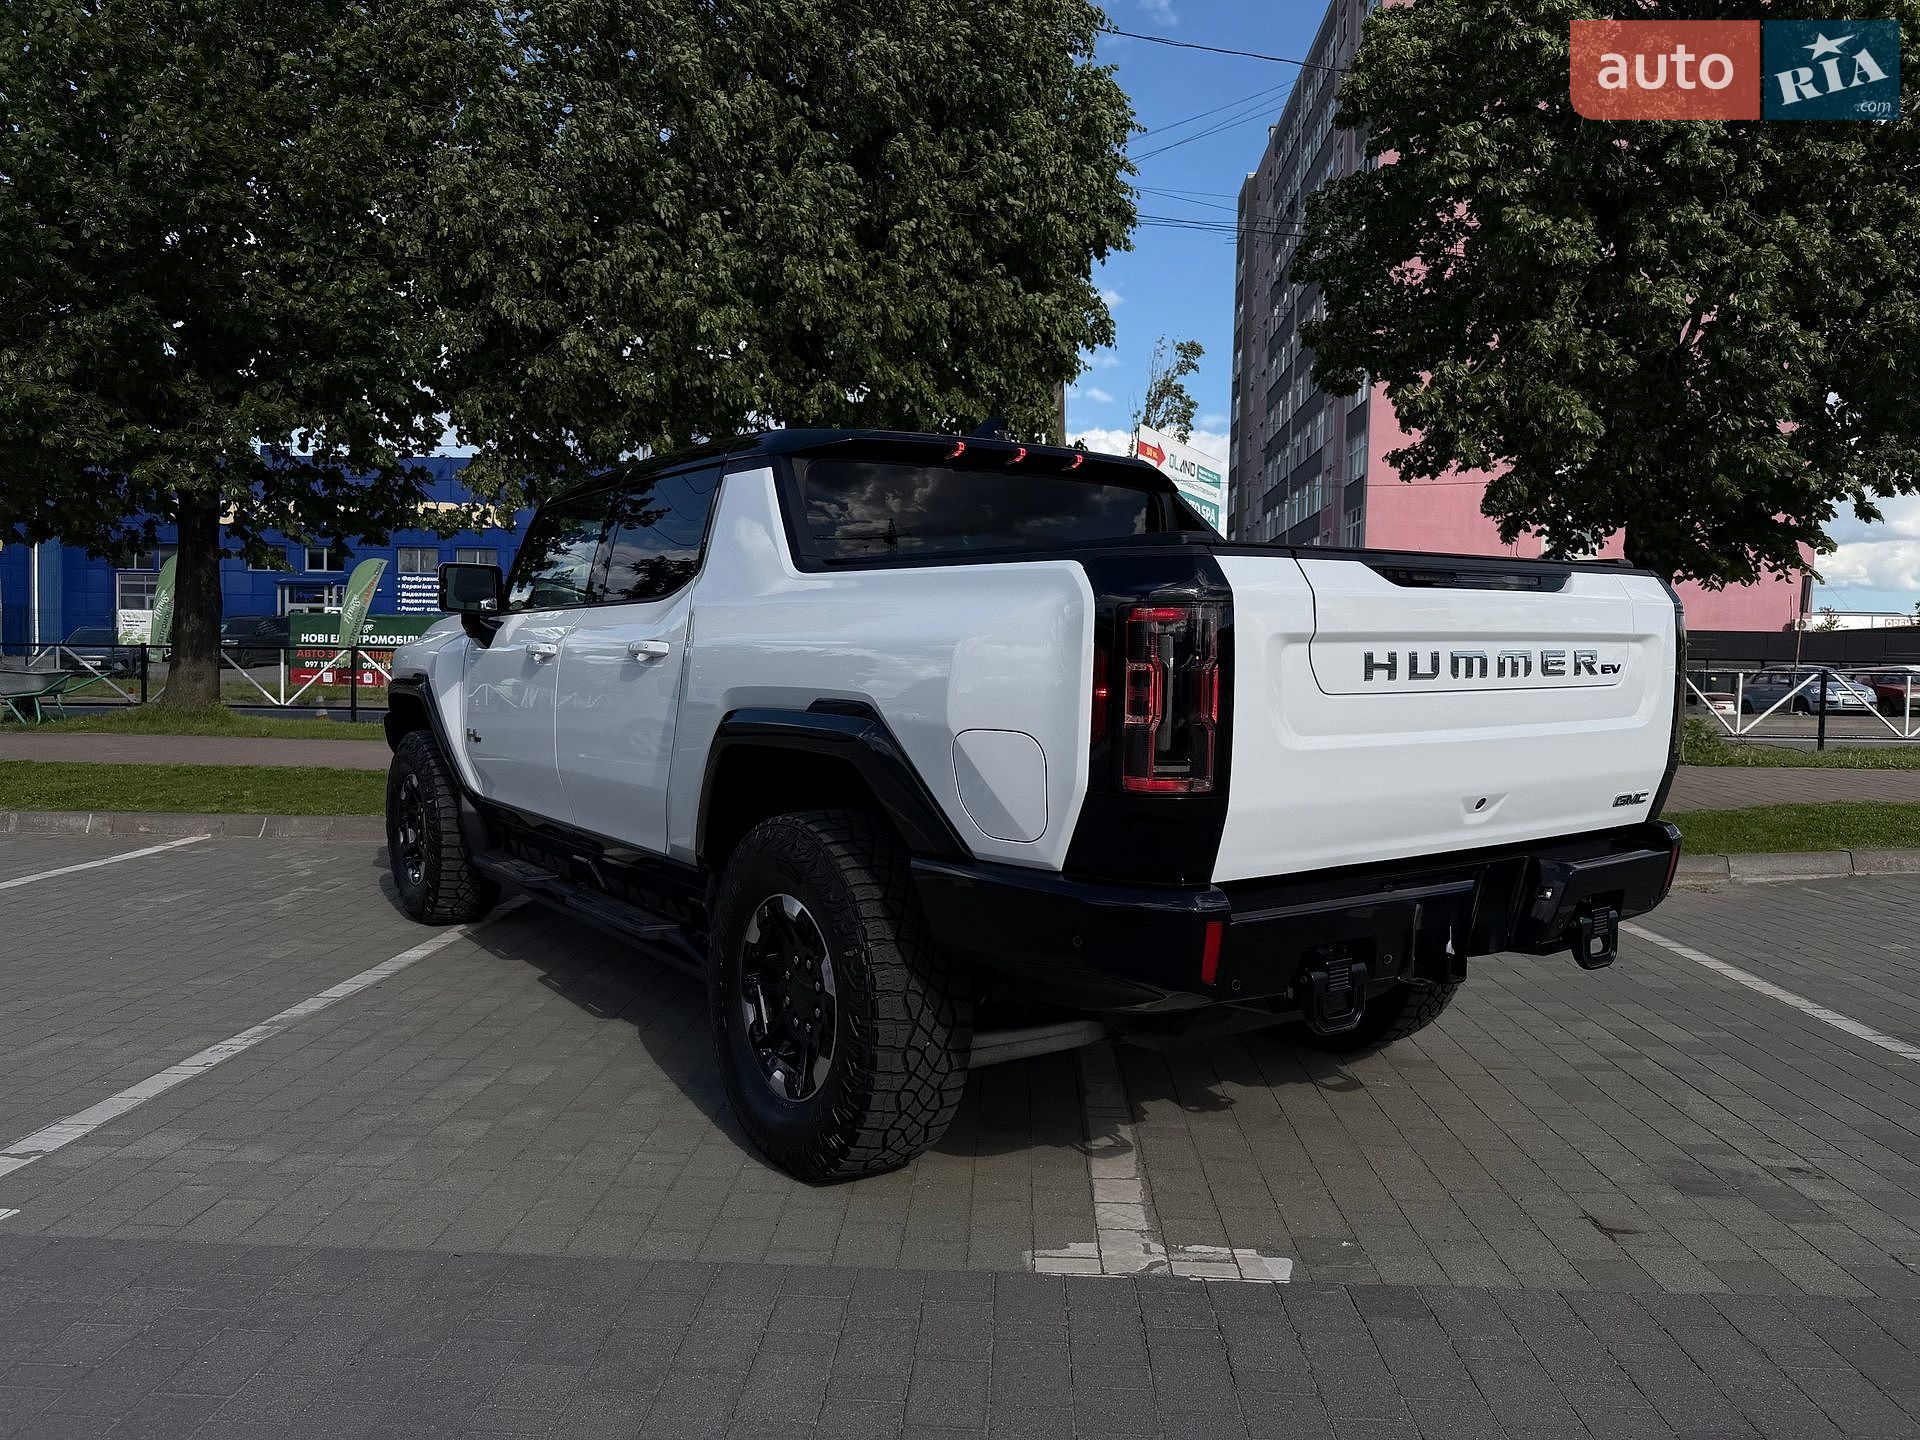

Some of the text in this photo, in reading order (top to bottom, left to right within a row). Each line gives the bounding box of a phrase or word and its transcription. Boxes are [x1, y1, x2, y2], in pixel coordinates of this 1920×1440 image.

[301, 633, 328, 643] НОВІ
[296, 650, 326, 658] АВТО
[1363, 649, 1621, 682] HUMMER EV
[1612, 792, 1649, 808] GMC
